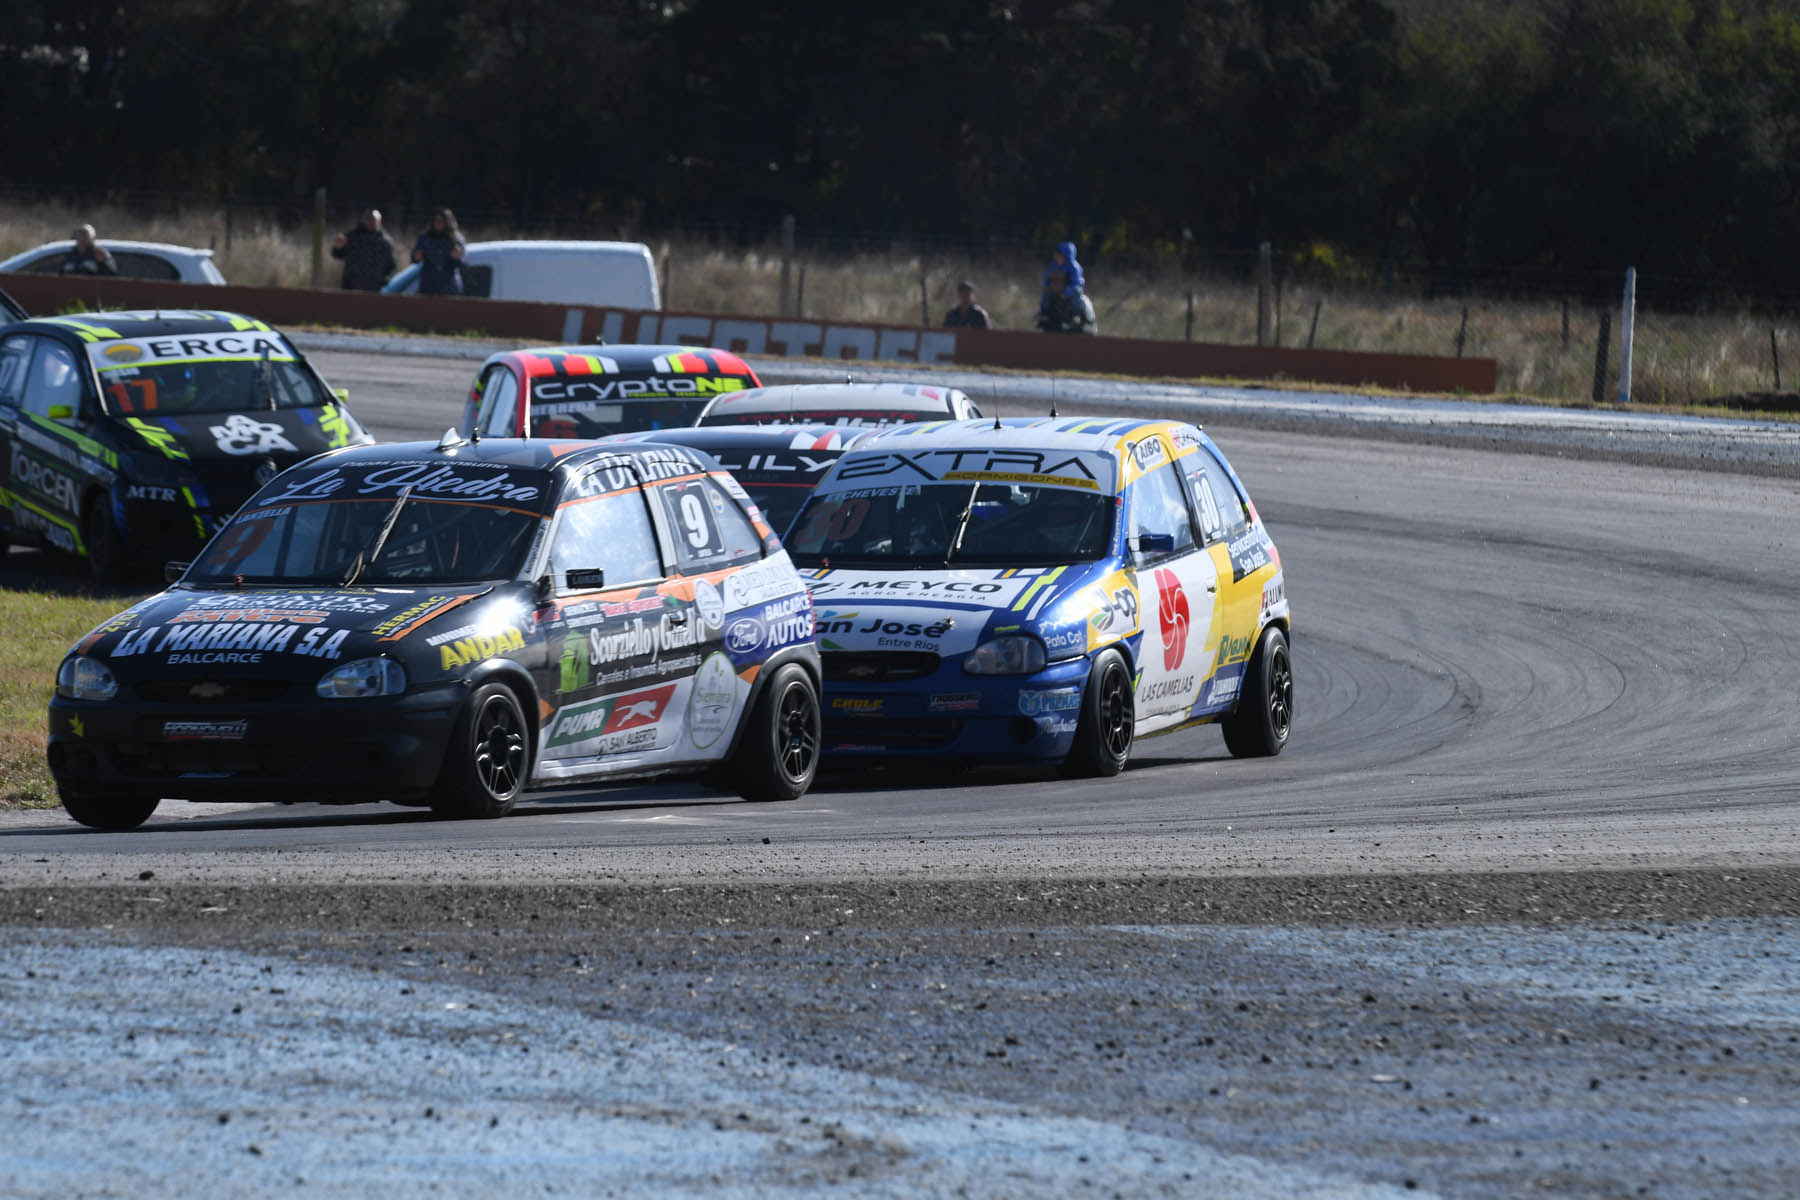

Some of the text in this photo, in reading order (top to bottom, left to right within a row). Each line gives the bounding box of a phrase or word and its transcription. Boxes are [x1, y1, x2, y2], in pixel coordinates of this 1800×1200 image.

[147, 338, 283, 358] ERCA
[106, 378, 158, 412] 17
[836, 450, 1096, 480] EXTRA
[681, 494, 709, 548] 9
[849, 580, 1003, 593] MEYCO
[764, 593, 811, 621] BALCARCE
[730, 622, 759, 649] Ford
[766, 615, 813, 649] AUTOS
[814, 619, 847, 634] an
[110, 627, 160, 657] LA
[155, 624, 298, 652] MARIANA
[878, 637, 912, 648] Entre
[166, 652, 262, 664] BALCARCE
[1141, 683, 1158, 703] LAS
